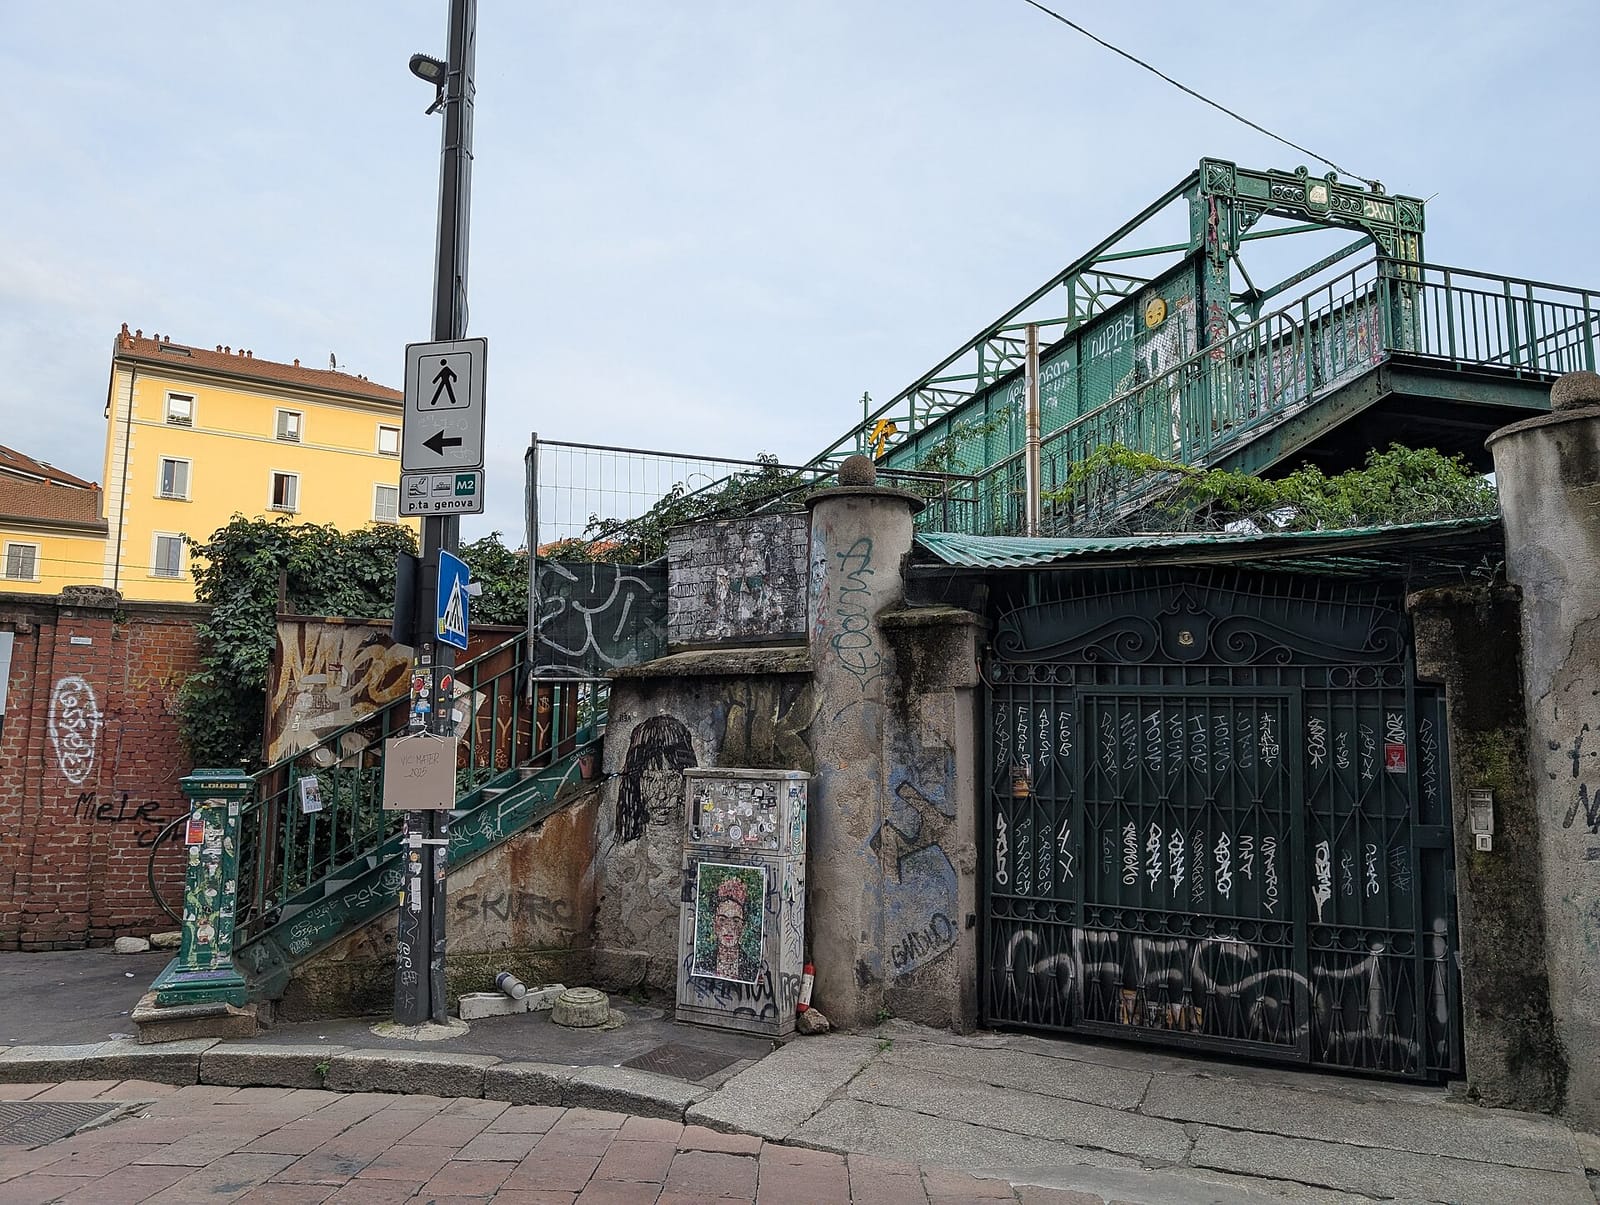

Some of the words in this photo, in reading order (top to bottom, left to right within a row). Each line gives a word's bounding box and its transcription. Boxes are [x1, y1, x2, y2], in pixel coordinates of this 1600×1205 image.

[457, 480, 475, 490] M2
[408, 501, 429, 511] p.ta
[434, 499, 473, 510] genova
